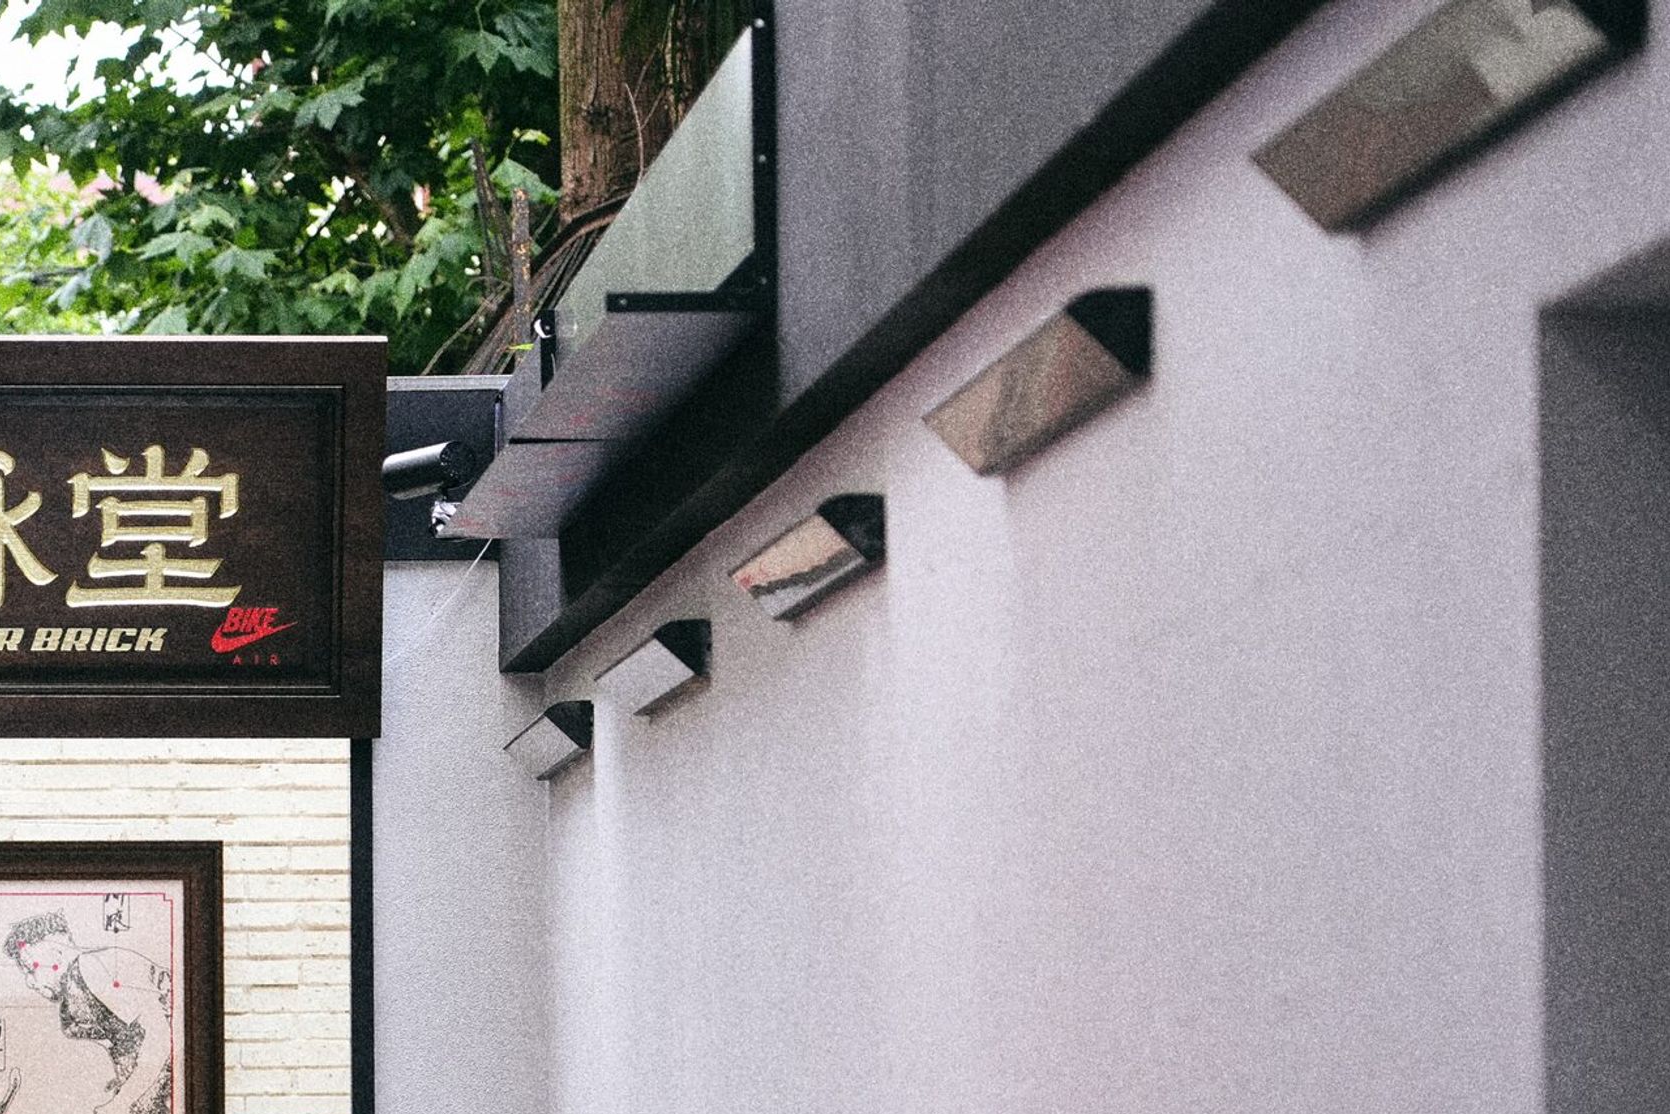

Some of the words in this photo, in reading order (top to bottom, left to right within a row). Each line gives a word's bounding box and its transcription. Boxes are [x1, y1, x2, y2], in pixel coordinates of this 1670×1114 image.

[222, 607, 279, 633] BIKE
[29, 627, 168, 652] BRICK
[232, 654, 280, 666] AIR
